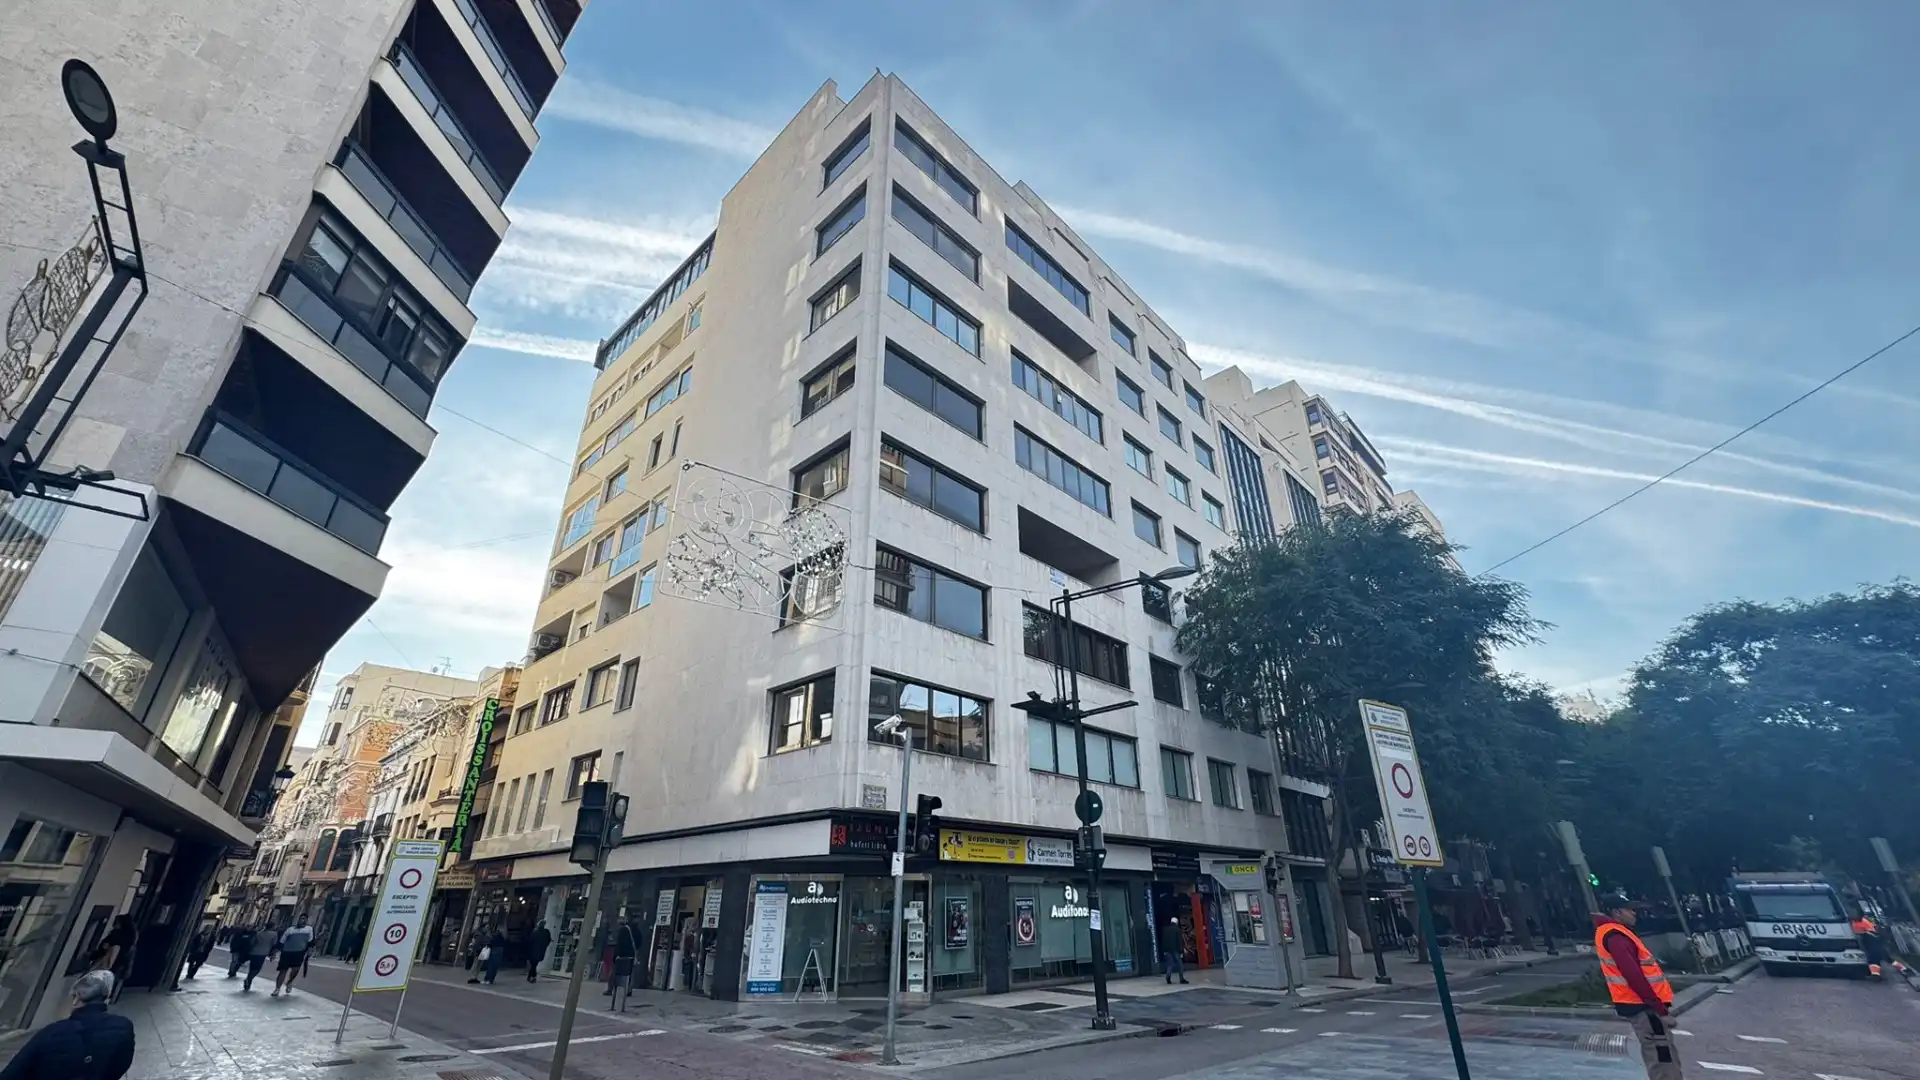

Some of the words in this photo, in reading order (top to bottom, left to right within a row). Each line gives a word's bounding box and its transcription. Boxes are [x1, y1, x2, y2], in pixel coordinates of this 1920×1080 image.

[450, 699, 498, 852] CROISSANTERIA
[1037, 848, 1056, 857] Carmen
[1057, 849, 1073, 859] Torres
[790, 896, 837, 905] Audiotechno
[390, 929, 402, 939] 10
[1771, 923, 1828, 935] ARNAU
